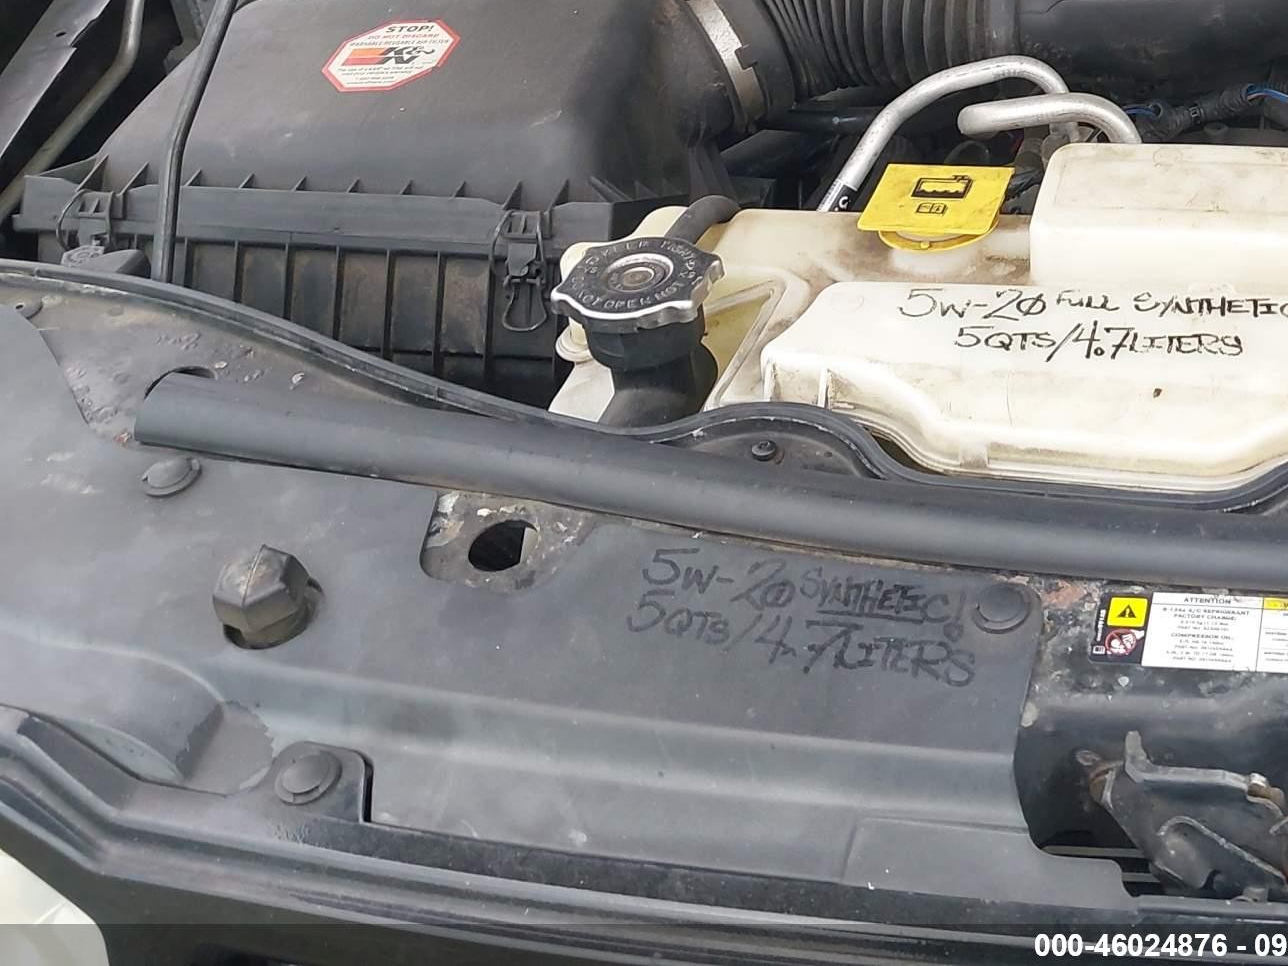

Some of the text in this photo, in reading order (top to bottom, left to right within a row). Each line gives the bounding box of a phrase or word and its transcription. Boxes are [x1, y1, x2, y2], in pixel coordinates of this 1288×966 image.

[385, 25, 435, 33] STOP!
[1056, 289, 1120, 312] FULL
[1184, 597, 1232, 605] ATTENTION
